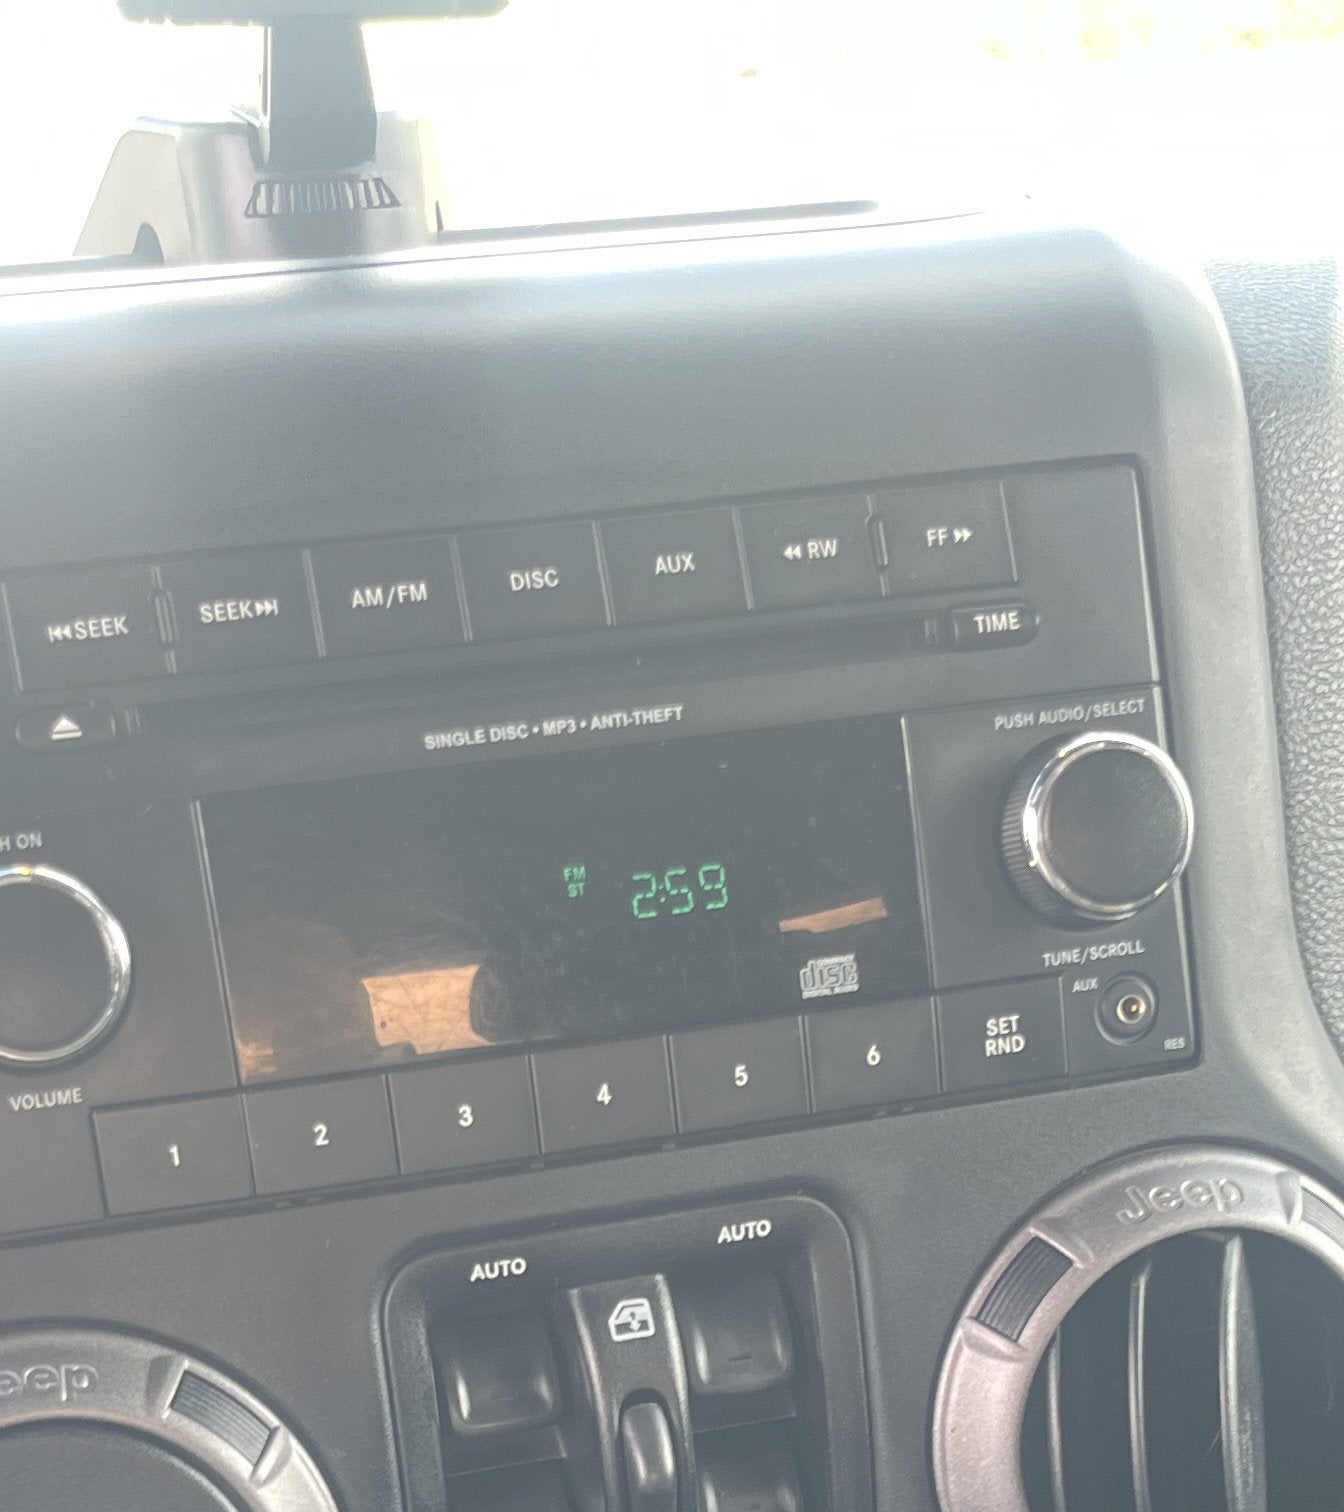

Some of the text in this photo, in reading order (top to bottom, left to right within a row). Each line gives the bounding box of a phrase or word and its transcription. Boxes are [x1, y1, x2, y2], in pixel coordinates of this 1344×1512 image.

[927, 527, 947, 546] FF
[807, 539, 837, 558] RW
[656, 553, 695, 574] AUX
[510, 568, 558, 590] DISC
[353, 582, 427, 608] AM/FM
[200, 600, 253, 623] SEEK
[974, 611, 1020, 633] TIME
[75, 615, 129, 640] SEEK
[995, 698, 1145, 730] PUSH AUDIO/SELECT
[424, 728, 486, 749] SINGLE
[489, 724, 530, 743] DISC
[542, 718, 576, 736] MP3
[591, 705, 683, 730] ANTI-THEFT
[16, 833, 42, 849] ON
[563, 864, 586, 881] FM
[568, 882, 585, 898] ST
[632, 863, 730, 919] 2:59
[1042, 940, 1144, 966] TUNE/SCROLL
[1073, 978, 1098, 992] AUX
[985, 1014, 1020, 1037] SET
[867, 1045, 880, 1065] 6
[984, 1034, 1026, 1057] RND
[735, 1065, 748, 1086] 5
[9, 1088, 82, 1111] VOLUME
[597, 1084, 611, 1104] 4
[459, 1105, 473, 1126] 3
[314, 1124, 329, 1145] 2
[170, 1145, 179, 1166] 1
[1116, 1175, 1245, 1225] Jeep
[718, 1219, 771, 1243] AUTO
[470, 1258, 526, 1282] AUTO
